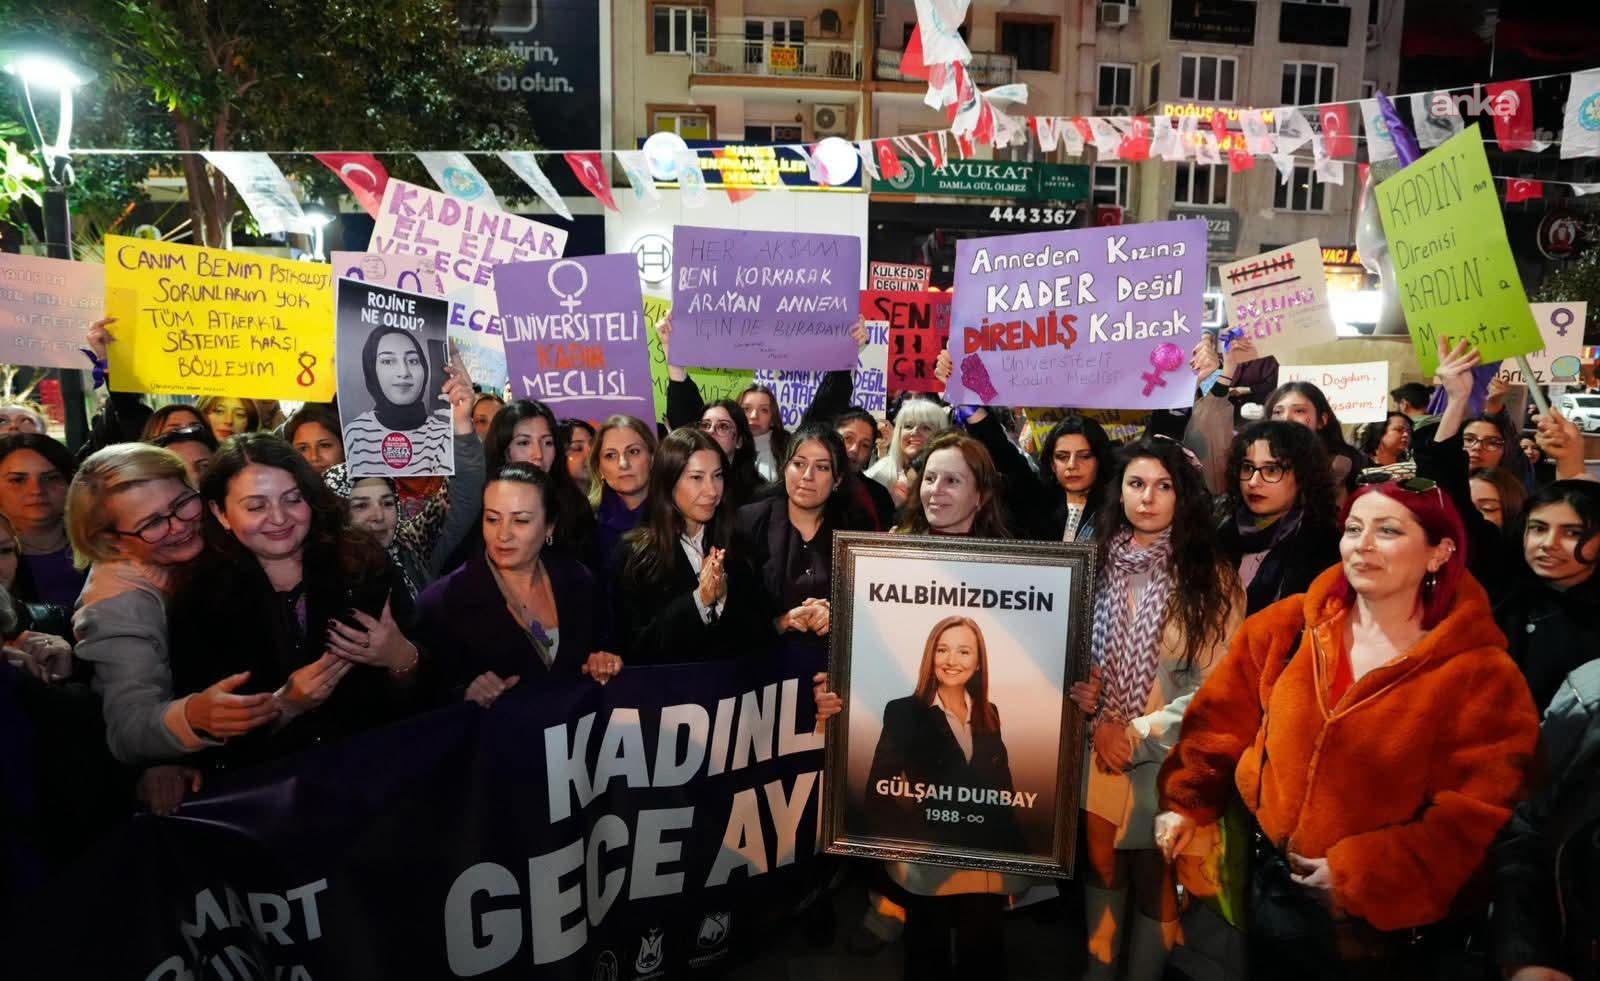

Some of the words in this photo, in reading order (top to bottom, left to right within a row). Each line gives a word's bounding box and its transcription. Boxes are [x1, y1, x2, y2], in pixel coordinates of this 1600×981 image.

[520, 72, 574, 92] olun.
[1164, 103, 1214, 122] DOĞUŞ
[932, 162, 1033, 180] AVUKAT
[939, 181, 973, 190] DAMLA
[974, 180, 994, 191] GÜL
[995, 182, 1027, 192] ÖLMEZ
[388, 183, 558, 257] KADINLAR
[393, 215, 439, 246] EL
[459, 231, 528, 265] ELE
[970, 245, 1080, 275] Anneden
[1106, 235, 1185, 264] Kızına
[118, 245, 186, 271] CANIM
[153, 277, 266, 303] SORUNLARIM
[276, 291, 310, 308] YOK
[735, 266, 832, 288] KORKARAK
[986, 272, 1097, 313] KADER
[1117, 269, 1183, 302] Değil
[368, 292, 416, 315] ROJİN'E
[688, 291, 760, 314] ARAYAN
[776, 295, 848, 313] ANNEM
[873, 297, 931, 329] SEN
[143, 308, 194, 329] TÜM
[361, 308, 379, 324] NE
[383, 312, 425, 330] OLDU?
[964, 310, 1078, 354] DİRENİŞ
[1089, 309, 1191, 344] Kalacak
[869, 580, 1053, 612] KALBİMİZDESİN
[543, 678, 825, 824] KADINL
[876, 776, 952, 803] GÜLŞAH
[958, 787, 1038, 808] DURBAY
[444, 806, 695, 977] GECE
[704, 770, 823, 888] AY
[180, 878, 328, 950] MART
